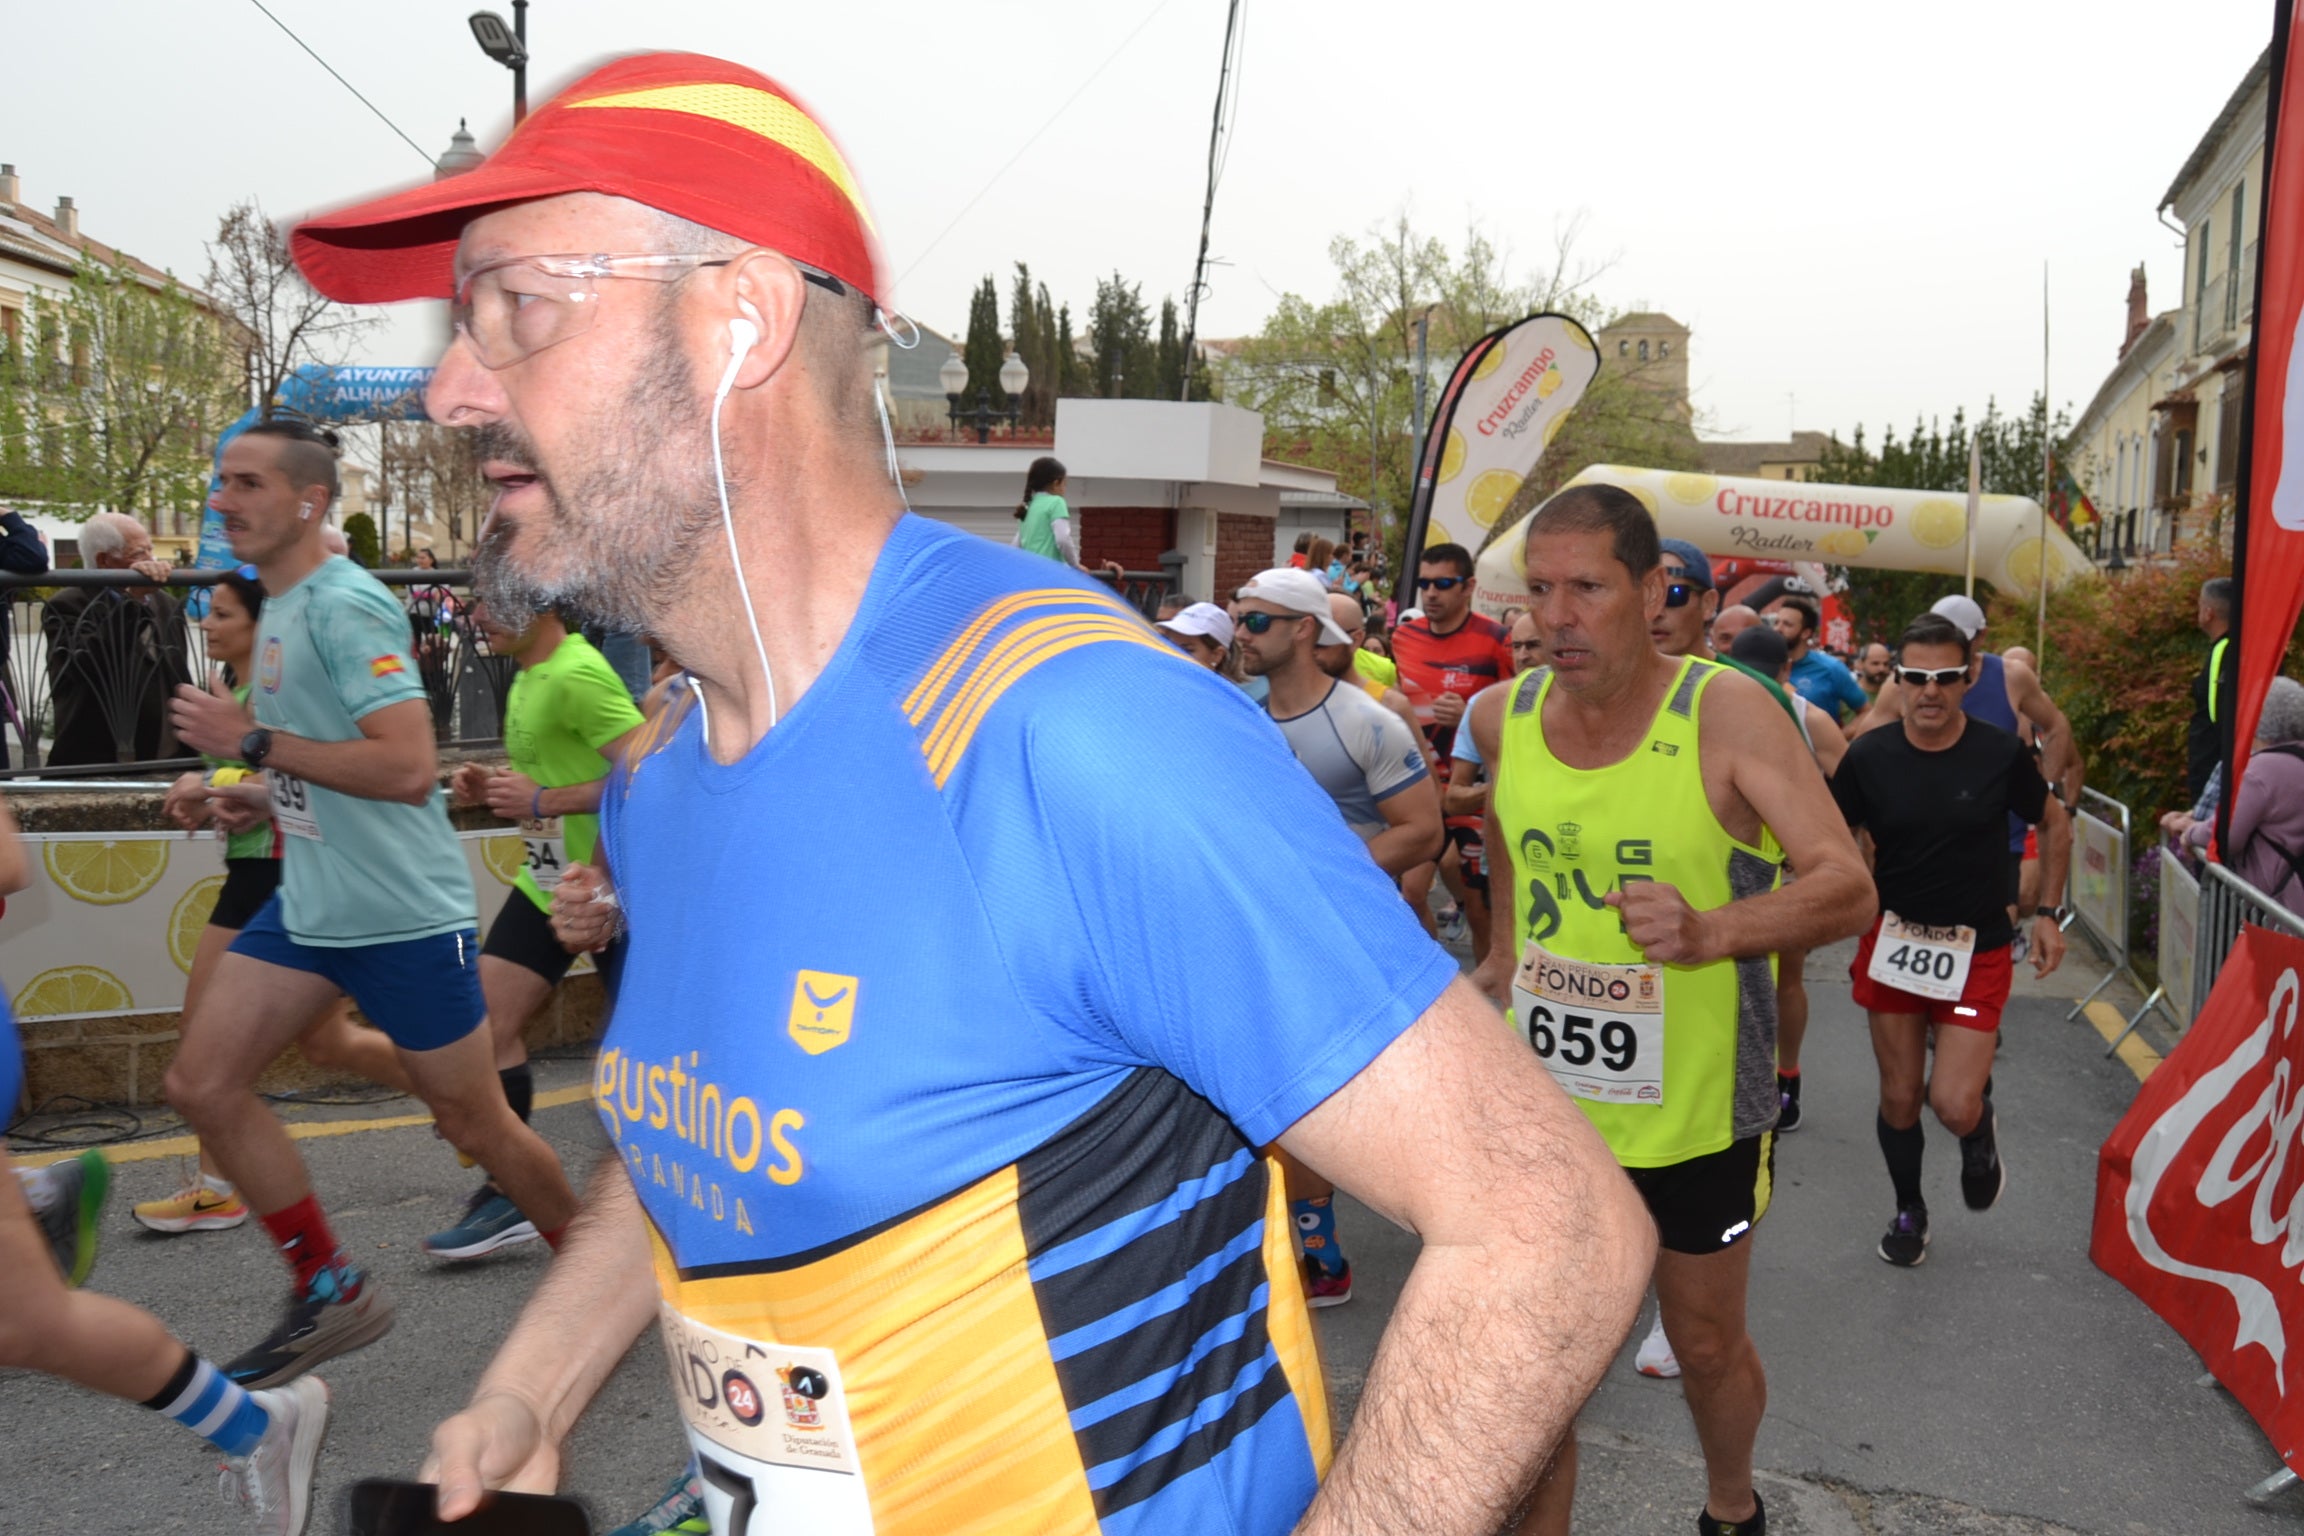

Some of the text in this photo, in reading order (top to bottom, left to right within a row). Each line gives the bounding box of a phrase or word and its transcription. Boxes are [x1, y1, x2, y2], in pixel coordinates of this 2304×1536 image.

[1476, 346, 1556, 437] Cruzcampo
[1502, 397, 1543, 440] Radler
[1716, 487, 1894, 529] Cruzcampo
[1731, 525, 1814, 551] Radler
[273, 770, 305, 812] 39
[1904, 922, 1957, 942] FONDO
[1537, 962, 1630, 1000] FONDO
[1887, 945, 1954, 981] 480
[1529, 1005, 1638, 1072] 659
[622, 1143, 755, 1236] RANADA
[669, 1338, 765, 1427] NDO
[728, 1385, 755, 1411] 24
